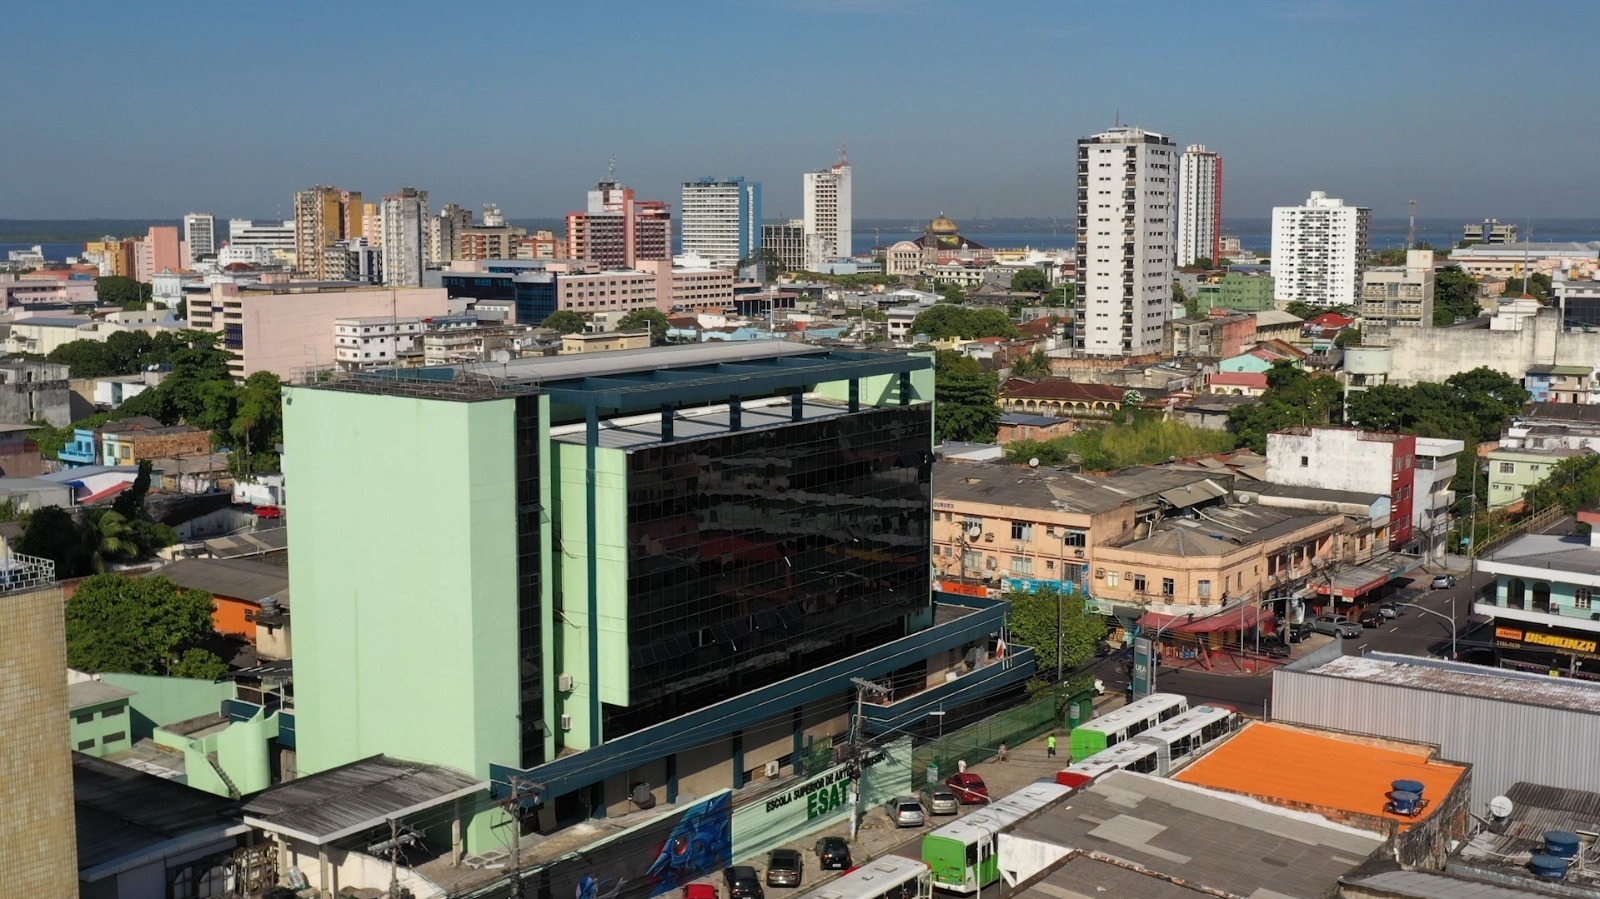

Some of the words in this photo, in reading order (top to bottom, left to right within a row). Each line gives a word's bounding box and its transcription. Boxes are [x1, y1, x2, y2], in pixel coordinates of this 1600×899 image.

[1135, 664, 1147, 673] UEA
[766, 793, 793, 813] ESCOLA
[793, 778, 825, 801] SUPERIOR
[825, 774, 834, 786] DE
[807, 778, 851, 820] ESAT
